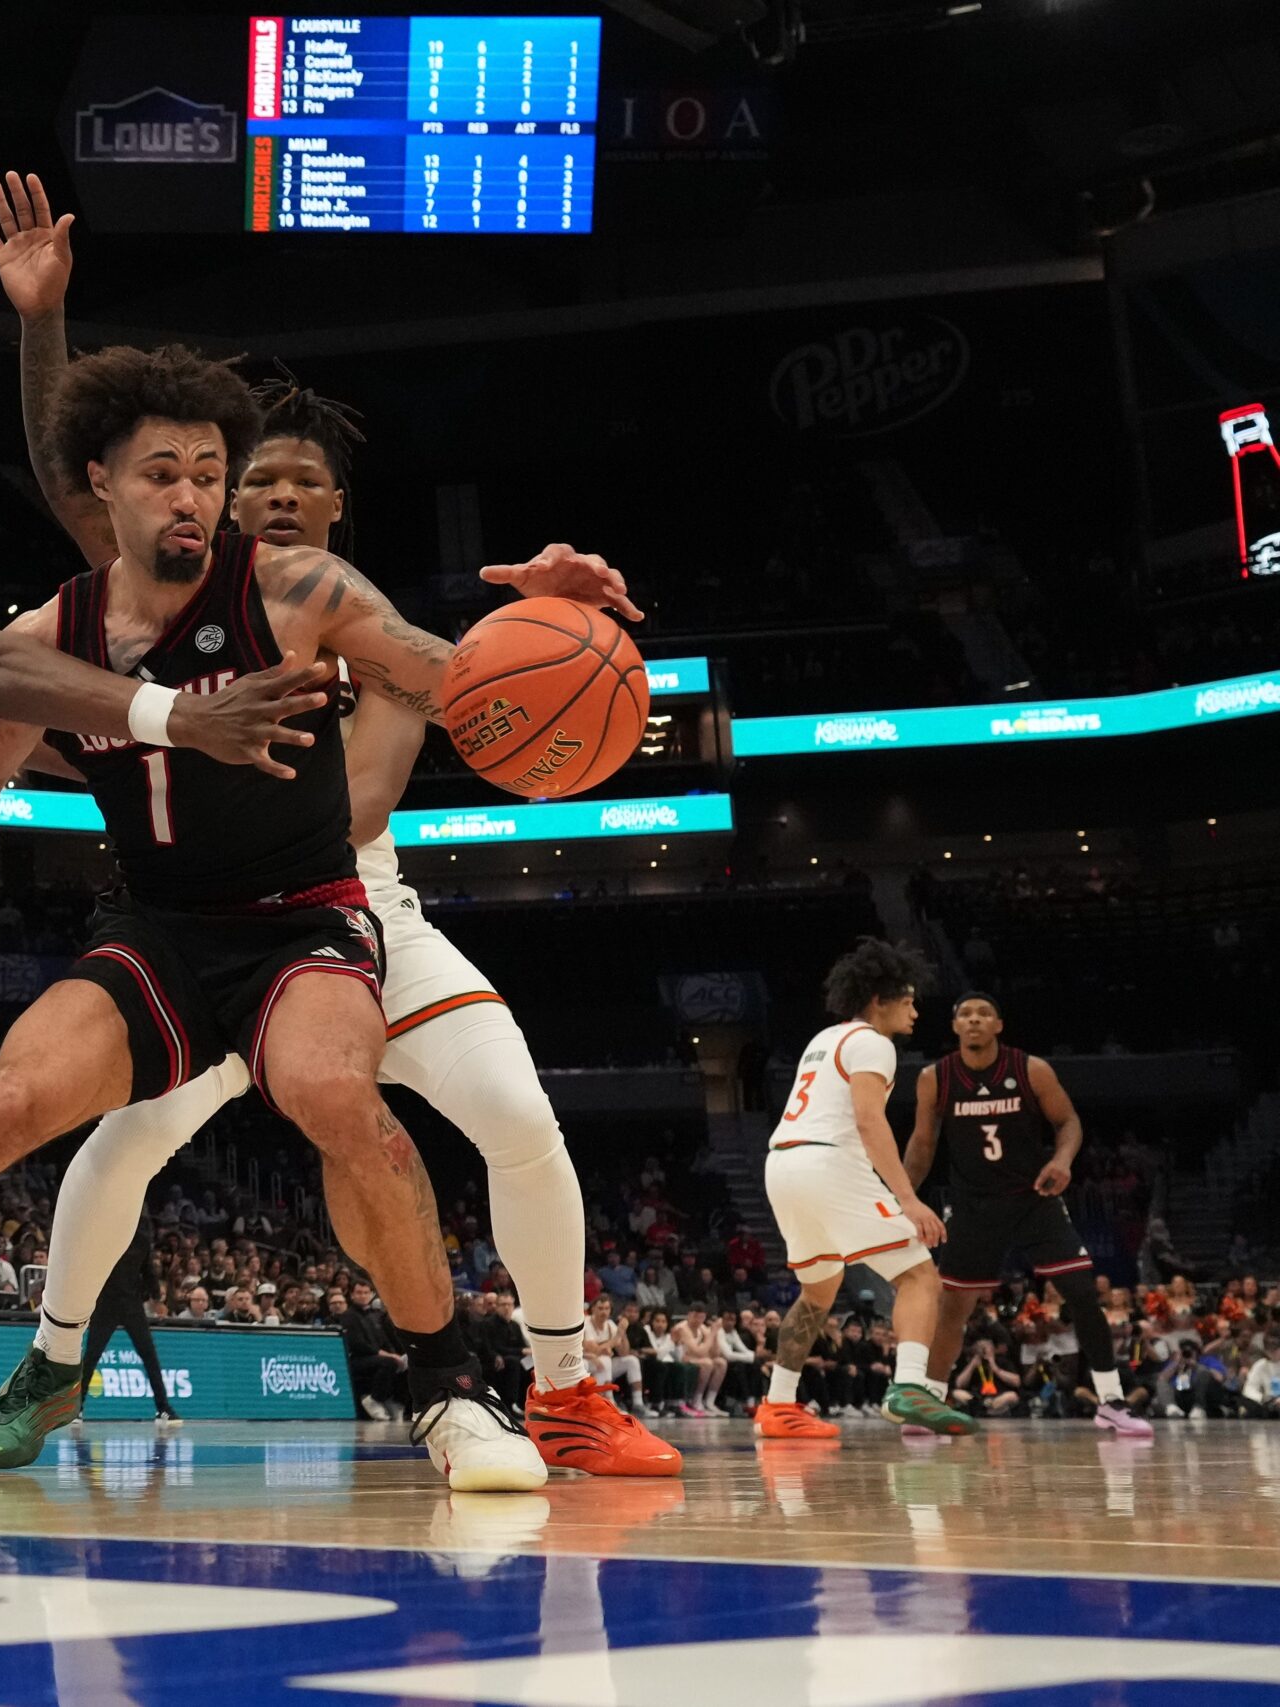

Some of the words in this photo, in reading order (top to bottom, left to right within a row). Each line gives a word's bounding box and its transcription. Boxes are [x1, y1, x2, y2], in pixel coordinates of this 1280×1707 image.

[292, 19, 361, 33] LOUISVILLE
[288, 40, 295, 53] 1
[305, 39, 347, 56] Hadley
[523, 40, 533, 54] 2
[570, 40, 578, 54] 1
[254, 20, 277, 117] CARDINALS
[286, 55, 295, 68] 3
[523, 56, 532, 70] 2
[570, 56, 577, 70] 1
[282, 70, 298, 83] 10
[304, 69, 363, 86] McKneely
[478, 70, 485, 84] 1
[522, 70, 532, 84] 2
[569, 70, 576, 84] 1
[282, 84, 297, 97] 11
[303, 84, 354, 101] Rodgers
[476, 85, 485, 99] 2
[523, 85, 531, 99] 1
[282, 100, 297, 113] 13
[303, 100, 324, 113] Fru
[428, 101, 438, 115] 4
[475, 101, 485, 115] 2
[566, 101, 576, 115] 2
[422, 122, 443, 134] PTS
[514, 122, 537, 134] AST
[288, 138, 327, 151] MIAMI
[283, 153, 292, 167] 3
[424, 154, 440, 168] 13
[474, 154, 483, 168] 1
[519, 154, 528, 168] 4
[564, 154, 573, 169] 3
[283, 168, 292, 182] 5
[563, 169, 573, 184] 3
[282, 183, 291, 196] 7
[301, 183, 366, 197] Henderson
[426, 183, 435, 198] 7
[472, 183, 482, 197] 7
[519, 183, 527, 198] 1
[563, 184, 572, 198] 2
[425, 198, 435, 213] 7
[562, 199, 571, 213] 3
[279, 213, 294, 227] 10
[300, 213, 370, 231] Washington
[422, 214, 438, 229] 12
[472, 214, 480, 229] 1
[516, 214, 526, 229] 2
[561, 214, 571, 229] 3
[792, 341, 953, 430] Pepper
[141, 750, 174, 845] 1
[419, 820, 516, 839] FLORIDAYS
[783, 1070, 817, 1122] 3
[954, 1096, 1021, 1117] LOUISVILLE
[980, 1124, 1004, 1162] 3
[261, 1357, 340, 1396] Kissimmee
